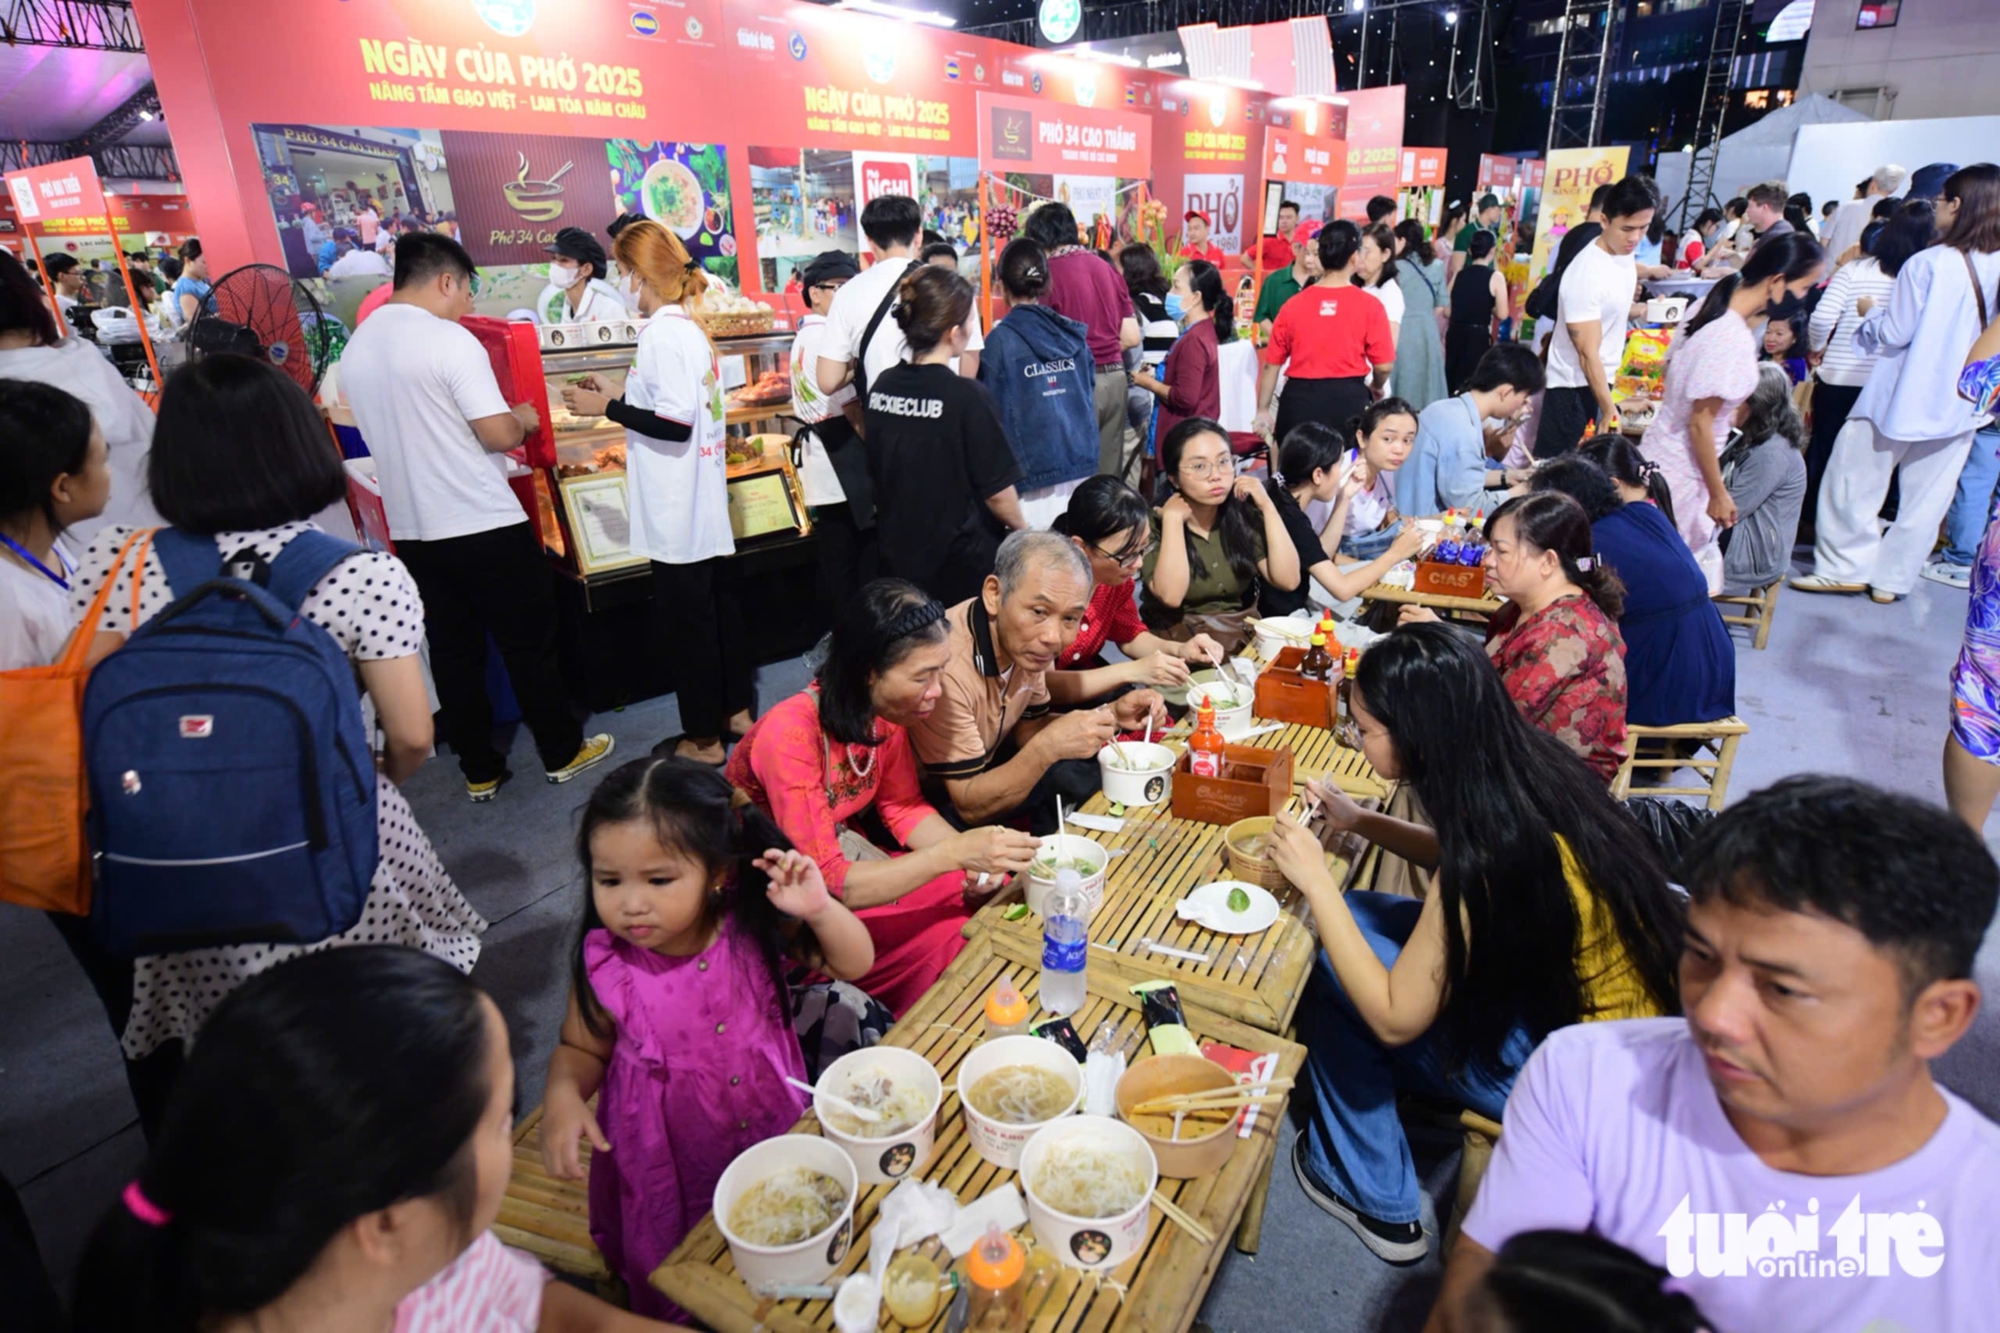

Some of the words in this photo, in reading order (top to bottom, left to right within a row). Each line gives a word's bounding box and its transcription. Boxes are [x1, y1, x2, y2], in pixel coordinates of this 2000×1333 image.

[359, 36, 446, 79] NGÀY
[455, 42, 516, 86] CỦA
[519, 52, 577, 91] PHỞ
[582, 62, 643, 98] 2025
[369, 80, 415, 103] NÂNG
[453, 89, 485, 109] GẠO
[487, 89, 516, 112] VIỆT
[530, 94, 555, 113] LAN
[615, 101, 646, 120] CHÂU
[804, 84, 848, 115] NGÀY
[851, 88, 883, 119] CỦA
[883, 93, 915, 122] PHỞ
[916, 99, 950, 125] 2025
[320, 134, 337, 147] 34
[339, 138, 364, 153] CAO
[1038, 119, 1064, 145] PHỞ
[1065, 125, 1079, 146] 34
[1081, 126, 1102, 149] CAO
[1104, 125, 1136, 151] THẮNG
[1363, 147, 1396, 164] 2025
[273, 173, 290, 185] 34
[1554, 160, 1614, 188] PHỞ
[867, 178, 909, 199] NGHI
[489, 230, 515, 247] Phở
[517, 230, 535, 245] 34
[1024, 357, 1076, 378] CLASSICS
[868, 392, 943, 419] RICXIECLUB
